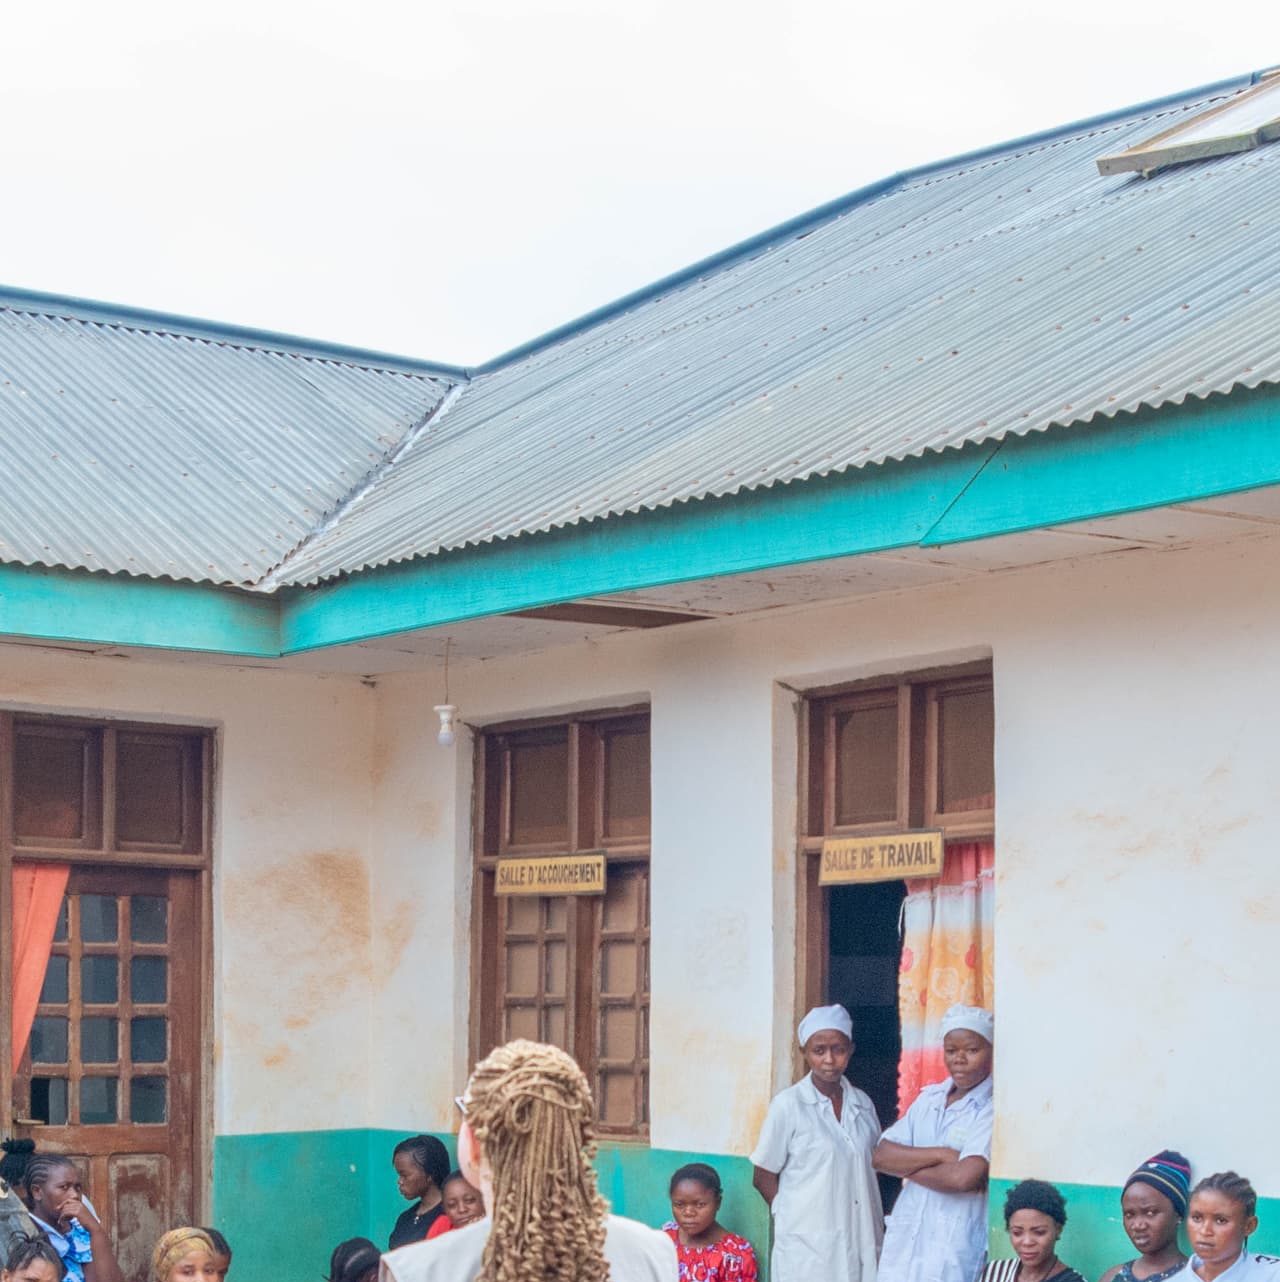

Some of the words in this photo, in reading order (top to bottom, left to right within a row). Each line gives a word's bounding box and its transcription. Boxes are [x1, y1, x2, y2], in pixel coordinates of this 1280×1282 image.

[824, 848, 857, 872] SALLE
[860, 846, 874, 870] DE
[879, 840, 937, 868] TRAVAIL
[500, 865, 525, 886] SALLE
[528, 862, 602, 886] D'ACCOUCHEMENT
